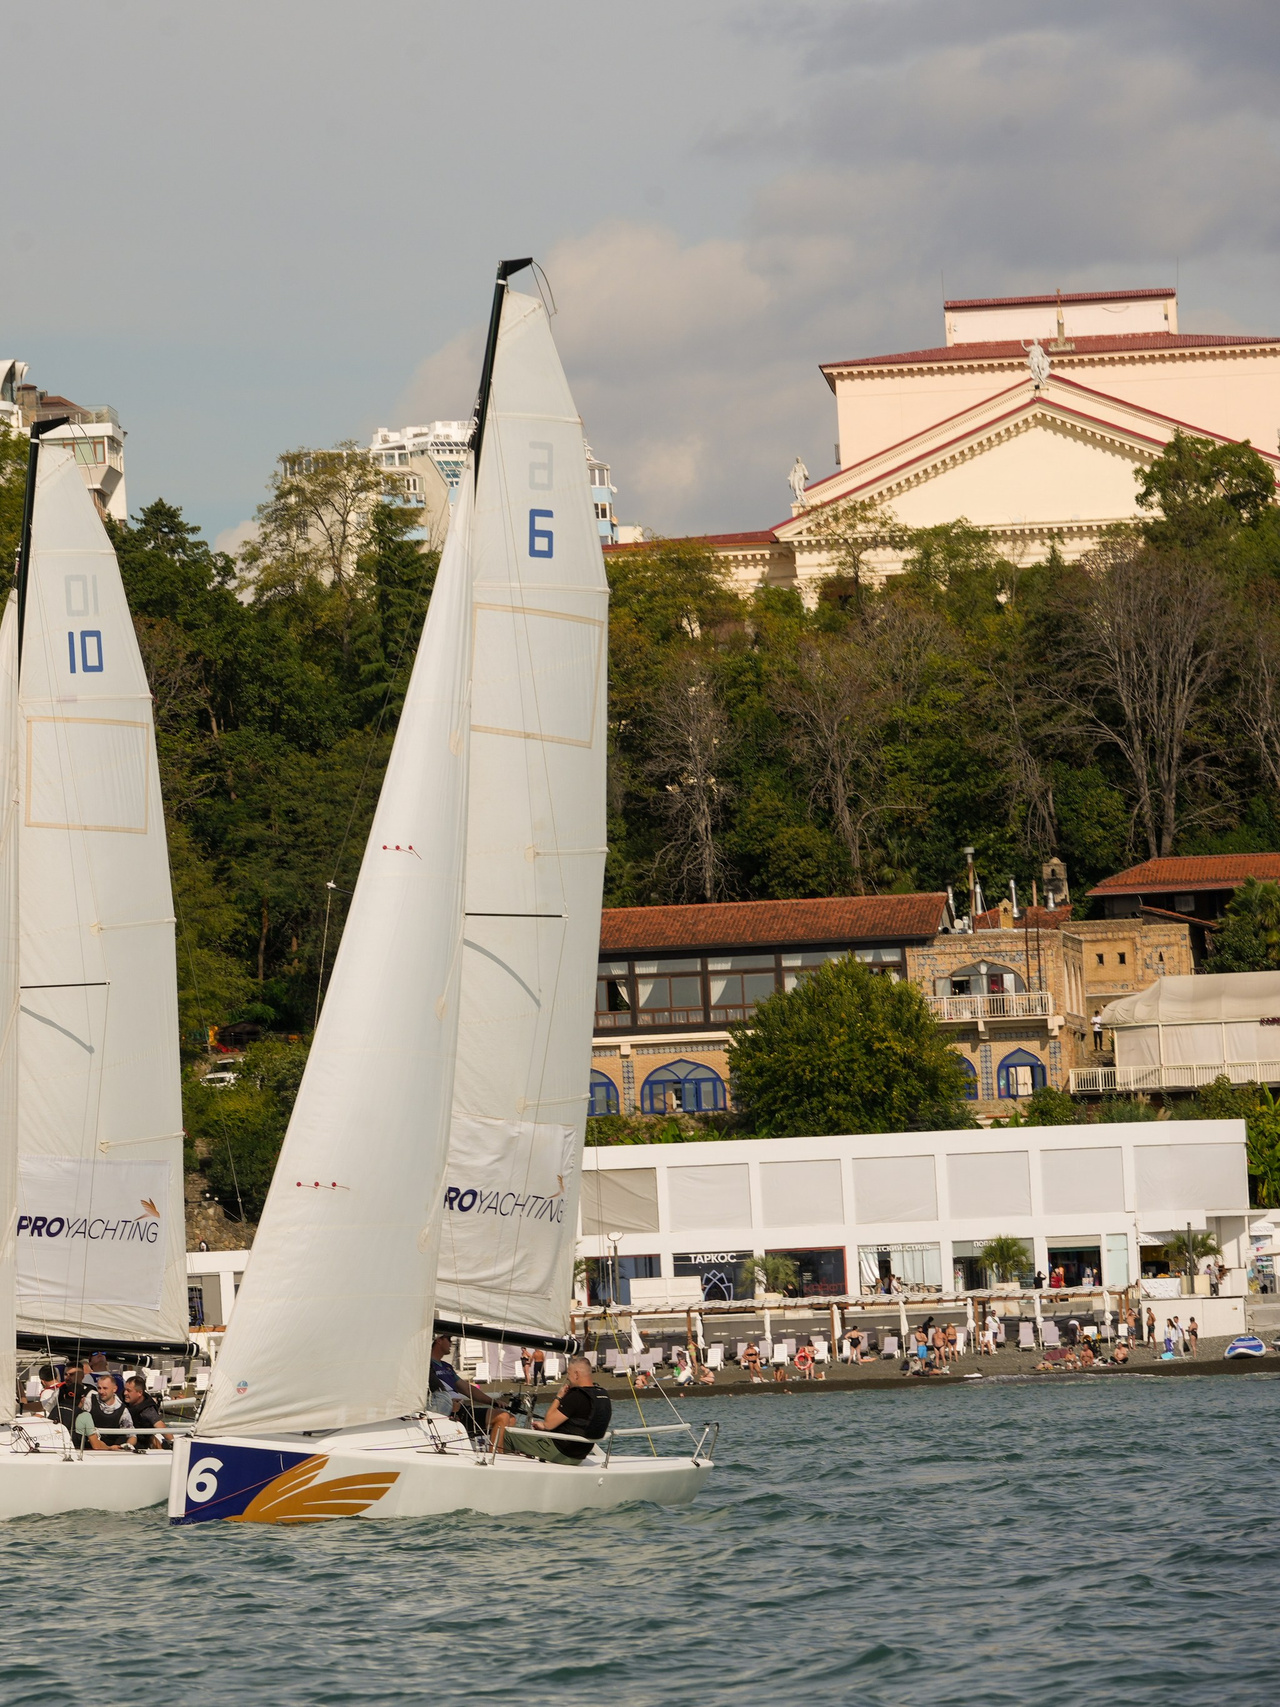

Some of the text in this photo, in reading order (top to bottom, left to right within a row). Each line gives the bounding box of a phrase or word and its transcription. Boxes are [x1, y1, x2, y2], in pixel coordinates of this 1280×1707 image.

[528, 508, 554, 559] 6
[67, 630, 104, 674] 10
[16, 1215, 160, 1243] PROYACHTING
[689, 1252, 737, 1264] ТАРКОС
[186, 1456, 224, 1503] 6
